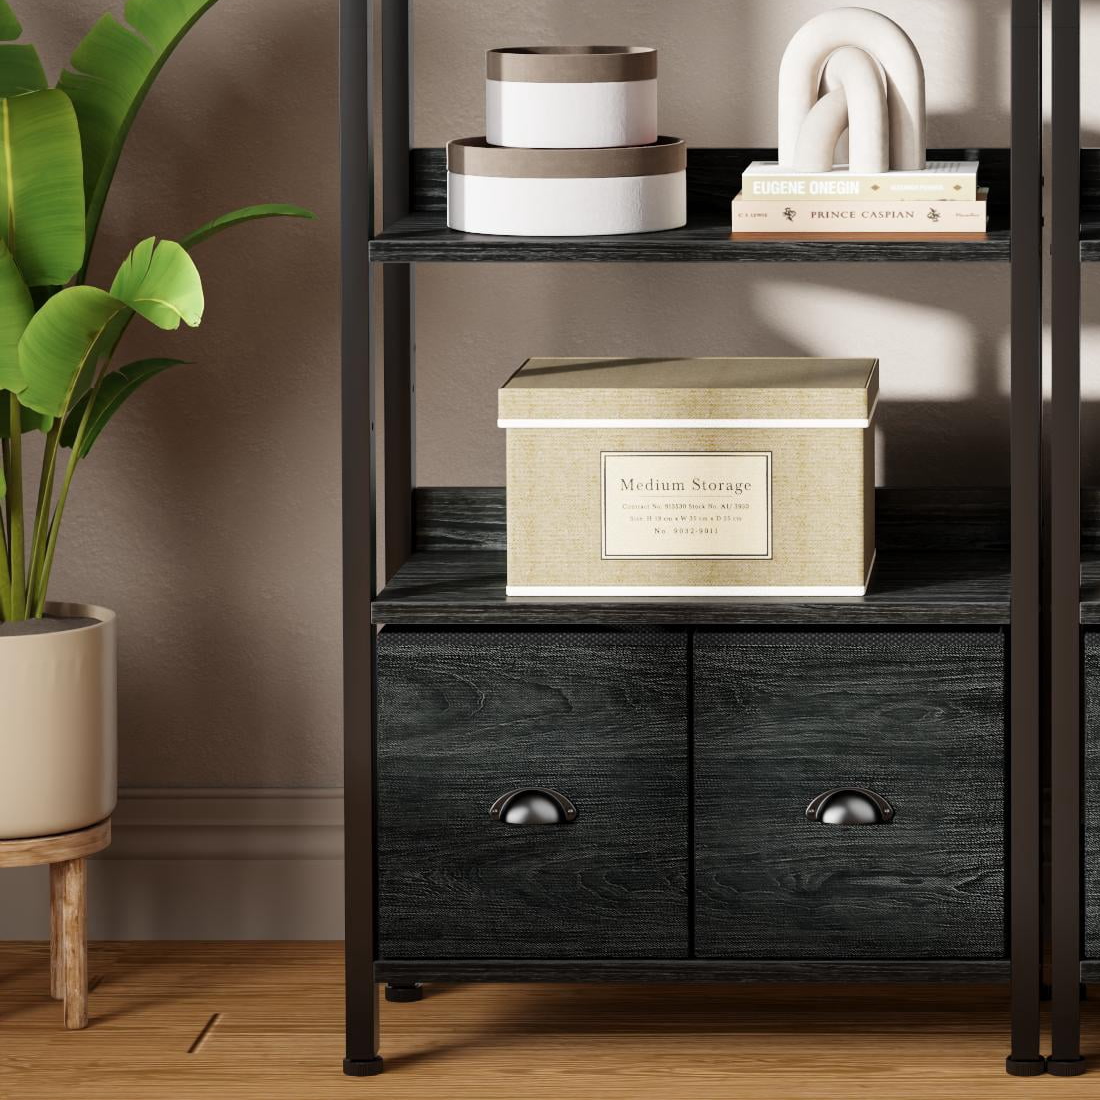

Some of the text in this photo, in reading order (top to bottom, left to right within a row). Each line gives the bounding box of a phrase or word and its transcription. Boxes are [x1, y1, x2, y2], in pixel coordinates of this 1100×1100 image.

[752, 180, 860, 195] EUGENE ONEGIN
[811, 210, 856, 219] PRINCE
[861, 210, 915, 219] CASPIAN
[620, 477, 753, 495] Medium Storage
